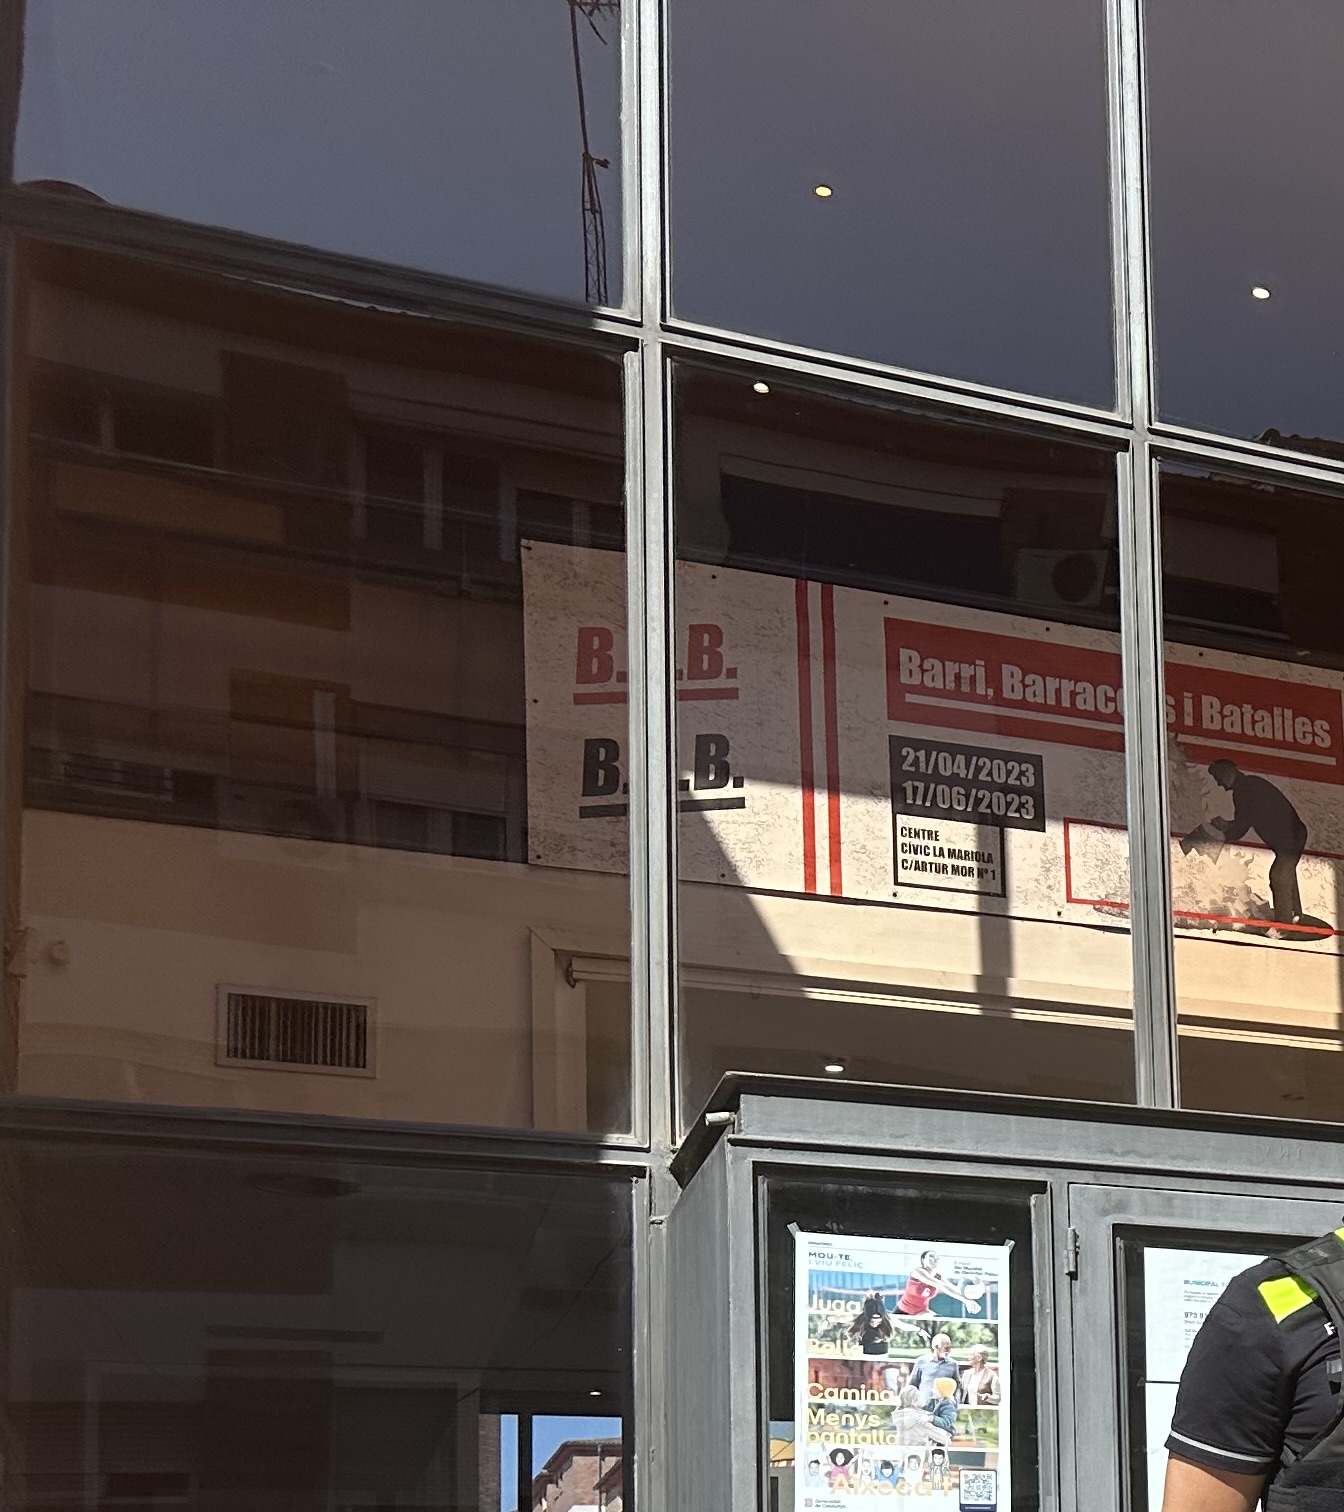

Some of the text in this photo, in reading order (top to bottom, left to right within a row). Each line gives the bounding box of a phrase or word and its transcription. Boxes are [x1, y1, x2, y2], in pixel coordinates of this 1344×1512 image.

[576, 623, 738, 684] B..B.
[900, 647, 1331, 748] Barri, Barracs i Batalles
[582, 733, 744, 797] B..B.
[901, 747, 1035, 787] 21/04/2023
[902, 780, 1035, 819] 17/06/2023
[900, 826, 940, 841] CENTRE
[901, 840, 994, 864] CÍVIC LA MARIOLA
[901, 859, 948, 875] C/ARTUR
[951, 865, 974, 878] MOR
[990, 869, 996, 880] 1
[806, 1383, 895, 1401] Camina
[806, 1408, 881, 1430] Menys
[806, 1429, 898, 1446] pantalla
